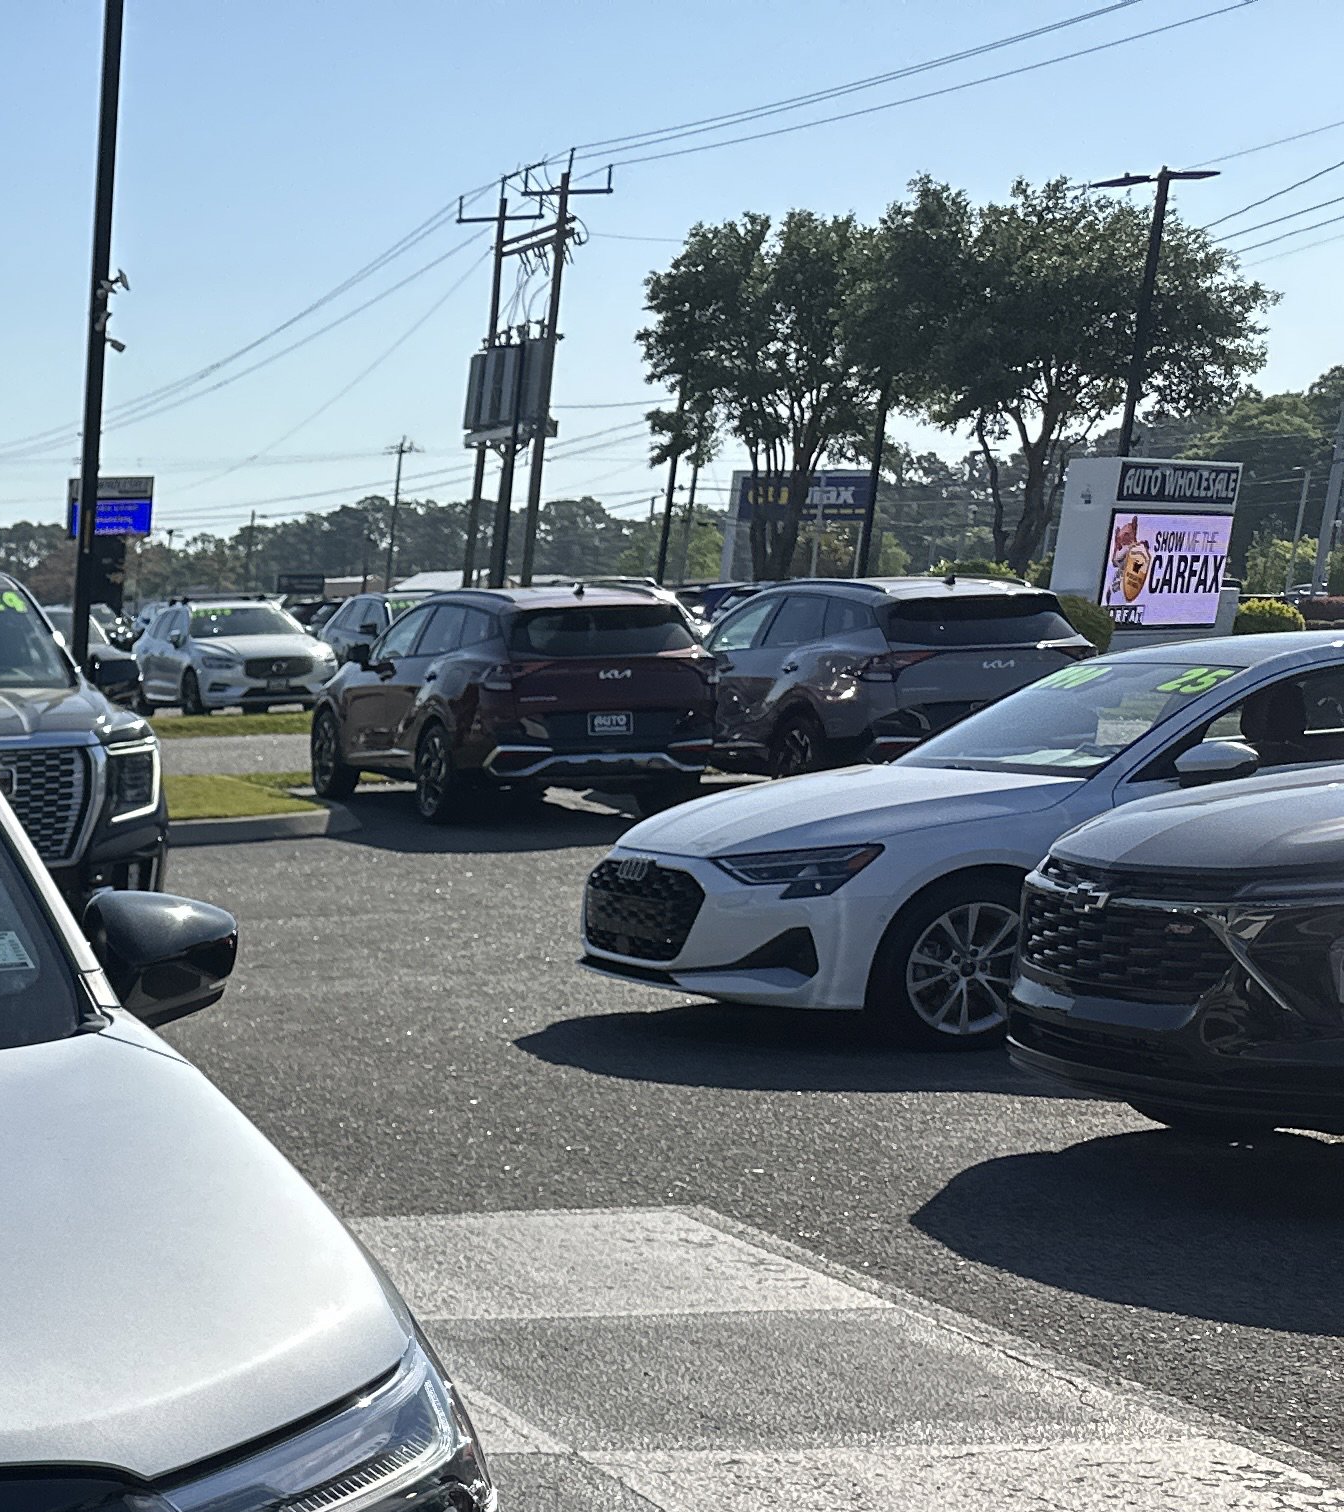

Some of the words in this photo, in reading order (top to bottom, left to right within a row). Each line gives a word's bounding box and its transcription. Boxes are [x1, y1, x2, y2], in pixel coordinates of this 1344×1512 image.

[1123, 468, 1162, 496] AUTO
[1163, 469, 1237, 500] WHOLESALE
[1154, 531, 1185, 552] SHOW
[1148, 554, 1225, 594] CARFAX
[1156, 668, 1235, 694] 25
[594, 714, 627, 726] AUTO
